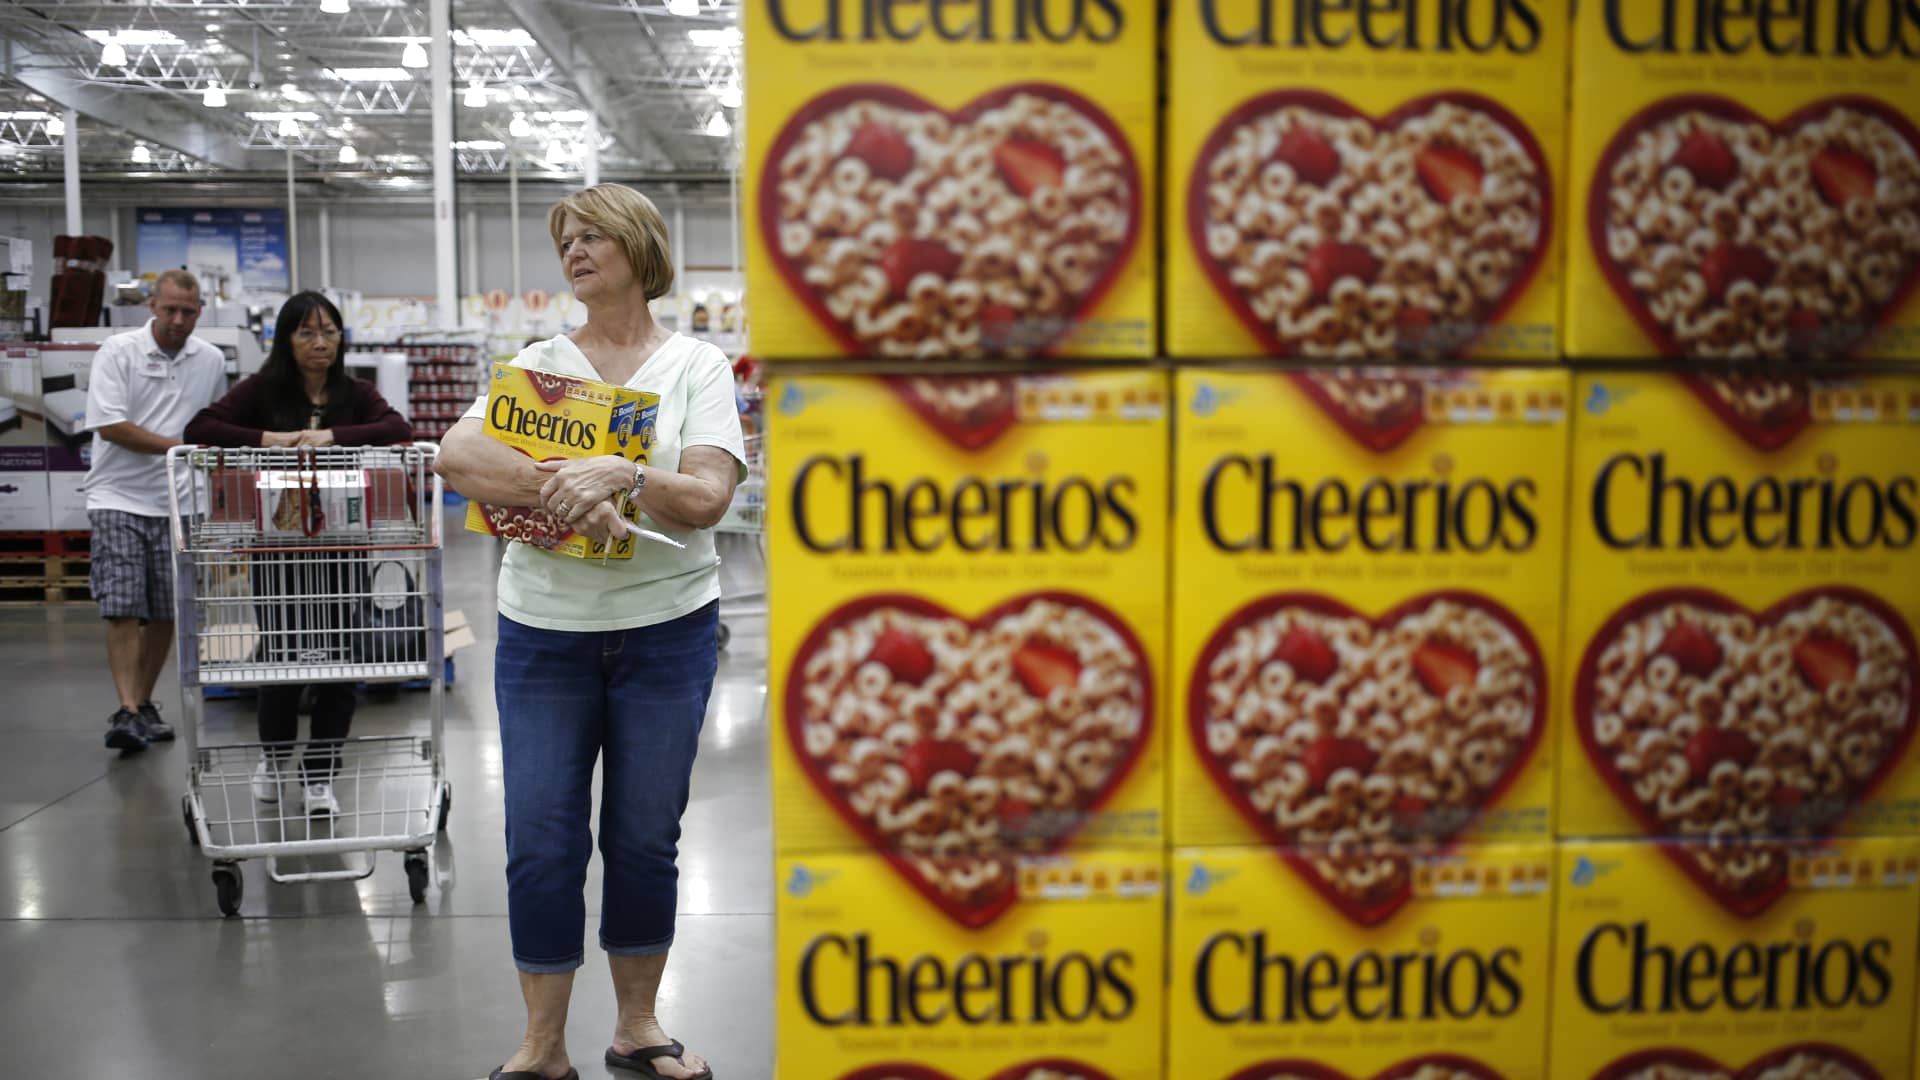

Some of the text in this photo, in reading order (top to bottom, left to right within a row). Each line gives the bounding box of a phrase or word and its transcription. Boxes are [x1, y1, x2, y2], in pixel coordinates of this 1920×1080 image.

[491, 394, 597, 450] Cheerios
[790, 450, 1140, 555] Cheerios
[1200, 452, 1539, 555] Cheerios
[1590, 451, 1919, 552] Cheerios
[798, 928, 1137, 1028] Cheerios
[1193, 926, 1524, 1026] Cheerios
[1574, 918, 1893, 1016] Cheerios
